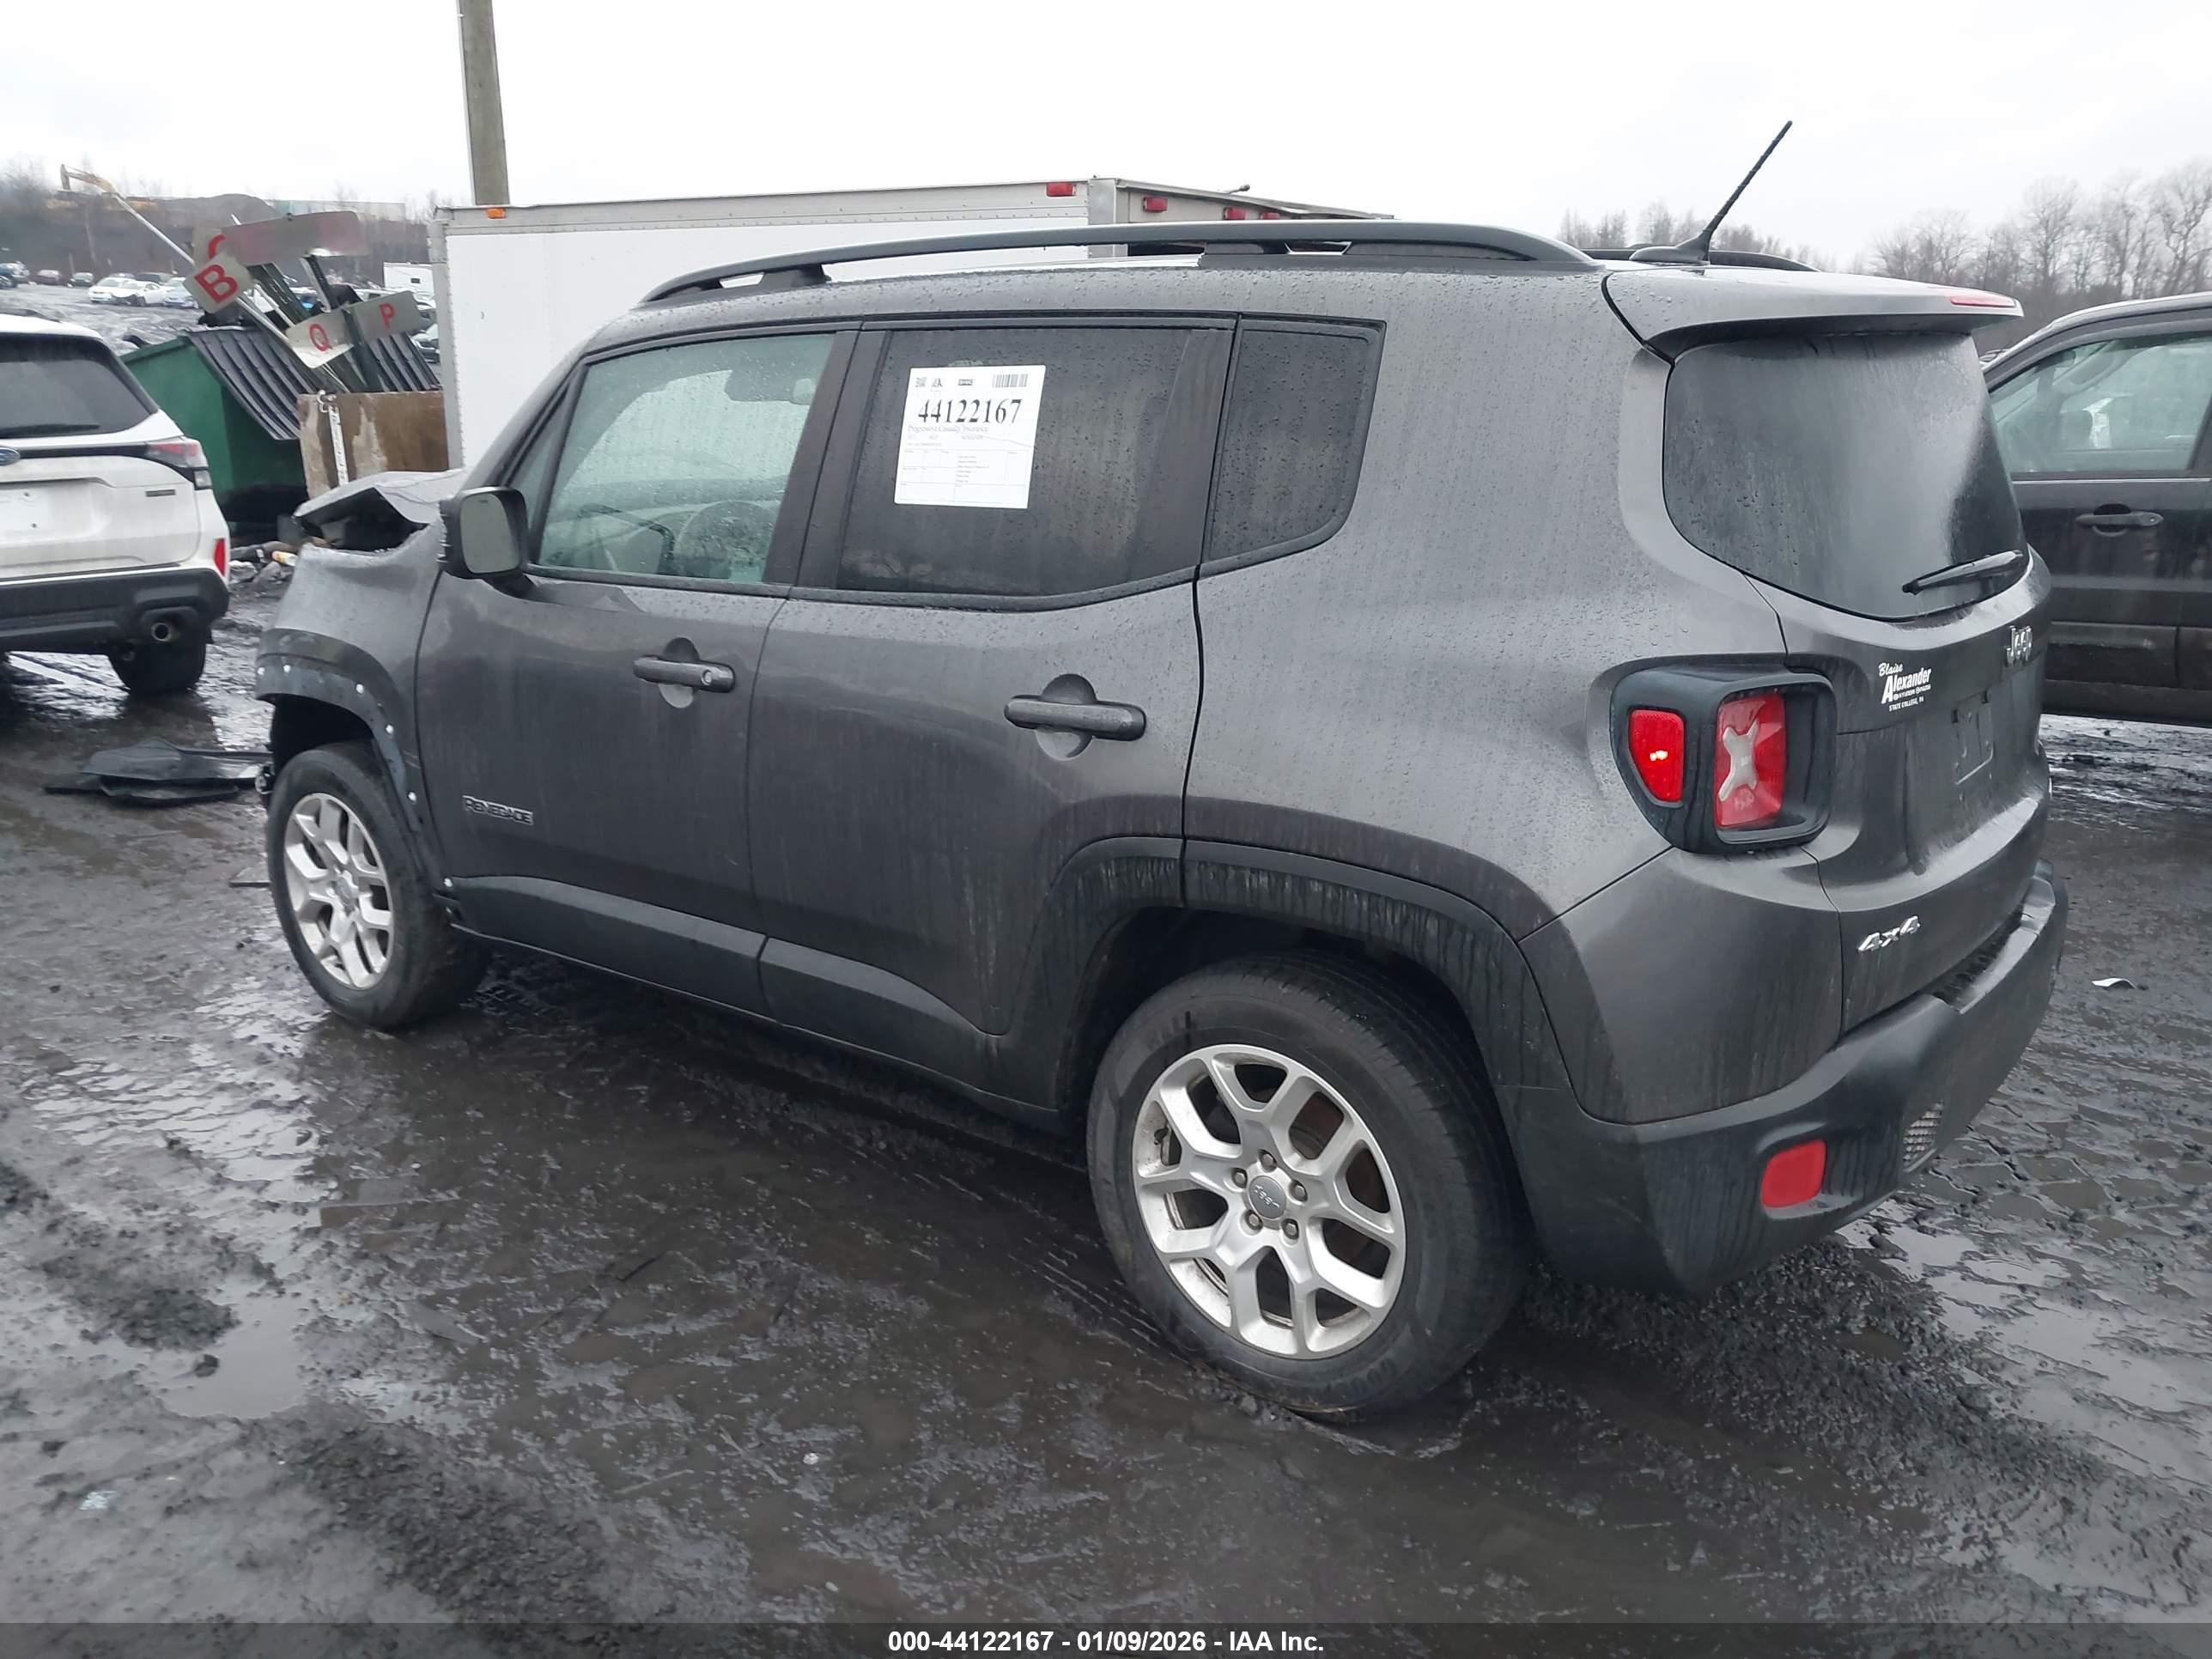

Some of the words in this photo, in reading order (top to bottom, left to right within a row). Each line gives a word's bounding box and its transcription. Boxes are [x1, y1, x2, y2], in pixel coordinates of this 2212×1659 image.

[194, 264, 238, 303] B
[379, 302, 395, 329] P
[308, 323, 332, 352] Q
[917, 398, 1022, 423] 44122167
[1881, 666, 1932, 704] Alexander
[1857, 915, 1921, 951] 4x4
